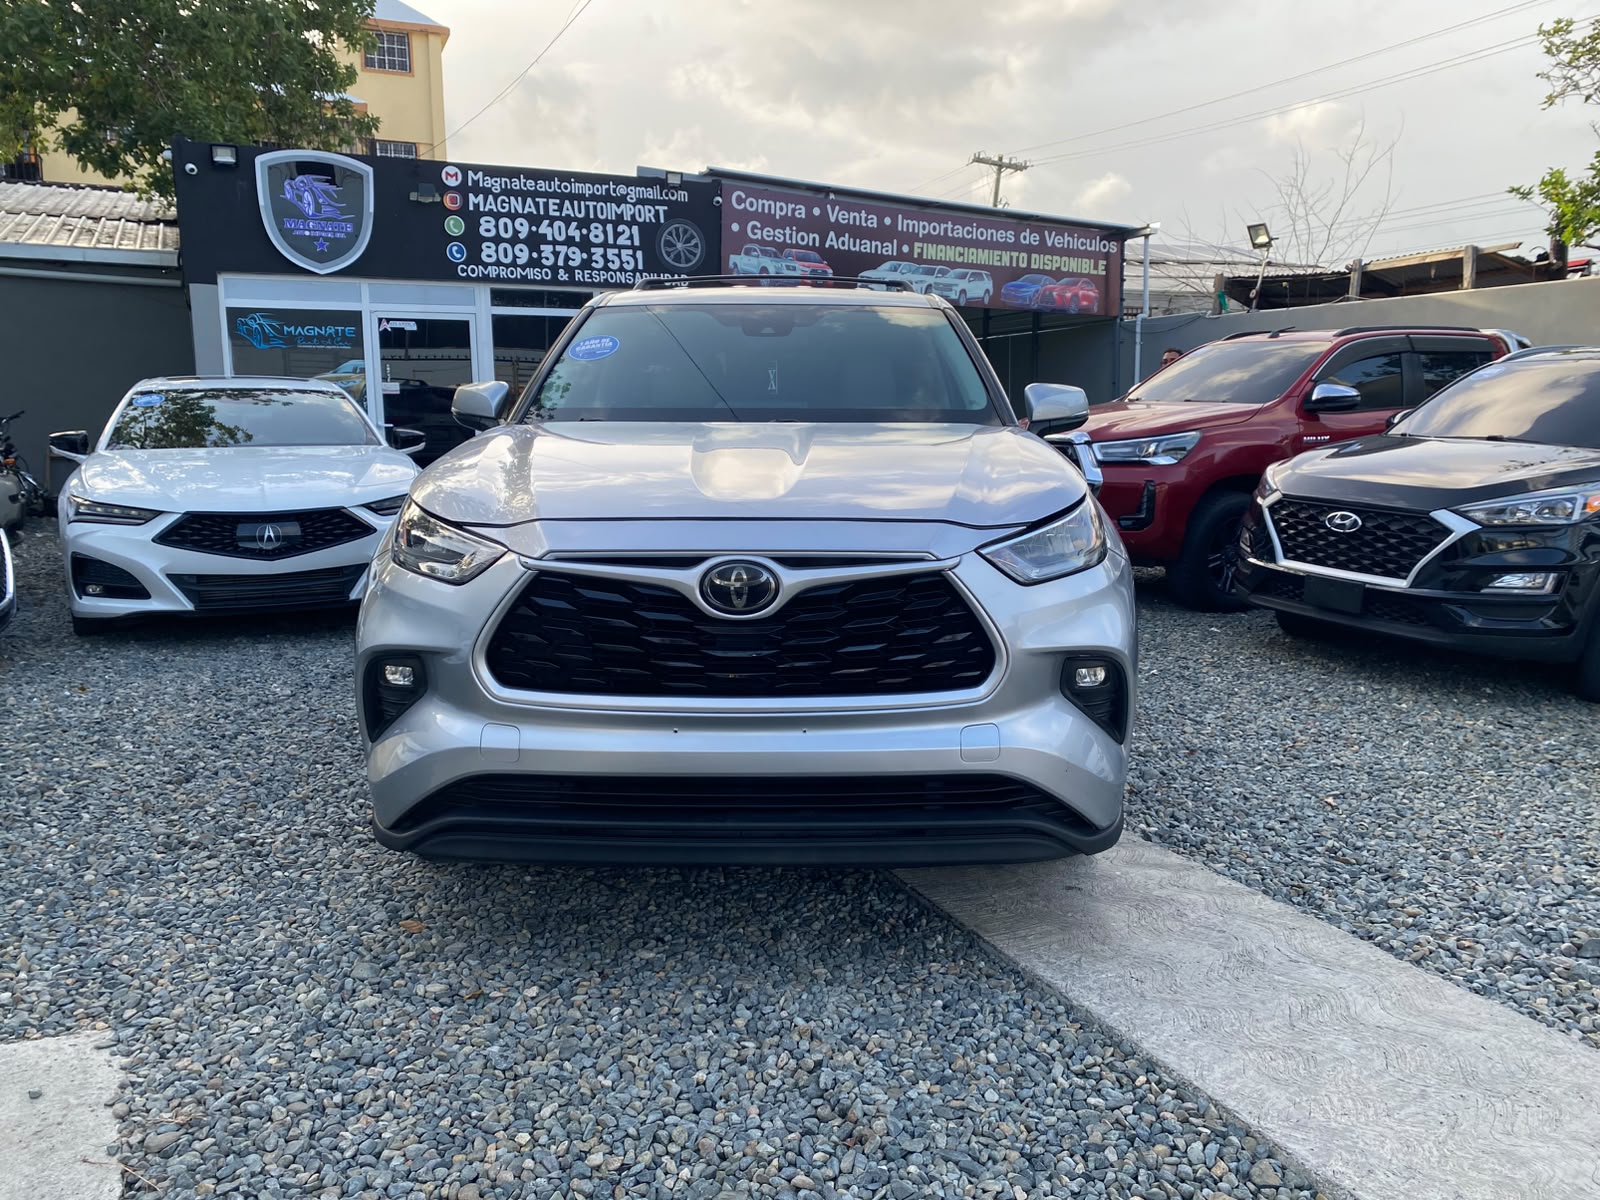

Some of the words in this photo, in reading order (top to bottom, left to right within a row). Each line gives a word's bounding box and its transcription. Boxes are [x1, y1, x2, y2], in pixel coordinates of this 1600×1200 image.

[467, 170, 688, 203] Magnateautoimport@gmail.com
[468, 192, 668, 223] MAGNATEAUTOIMPORT
[731, 190, 806, 219] Compra
[826, 204, 878, 228] Venta
[897, 214, 1015, 243] Importaciones
[1020, 228, 1040, 245] de
[1044, 230, 1118, 253] Vehiculos
[283, 218, 353, 232] MAGNATE
[746, 220, 820, 247] Gestion
[825, 231, 897, 256] Aduanal
[913, 242, 1028, 268] FINANCIAMIENTO
[1030, 253, 1107, 275] DISPONIBLE
[457, 264, 552, 280] COMPROMISO
[557, 268, 569, 281] &
[283, 325, 356, 337] MAGNATE
